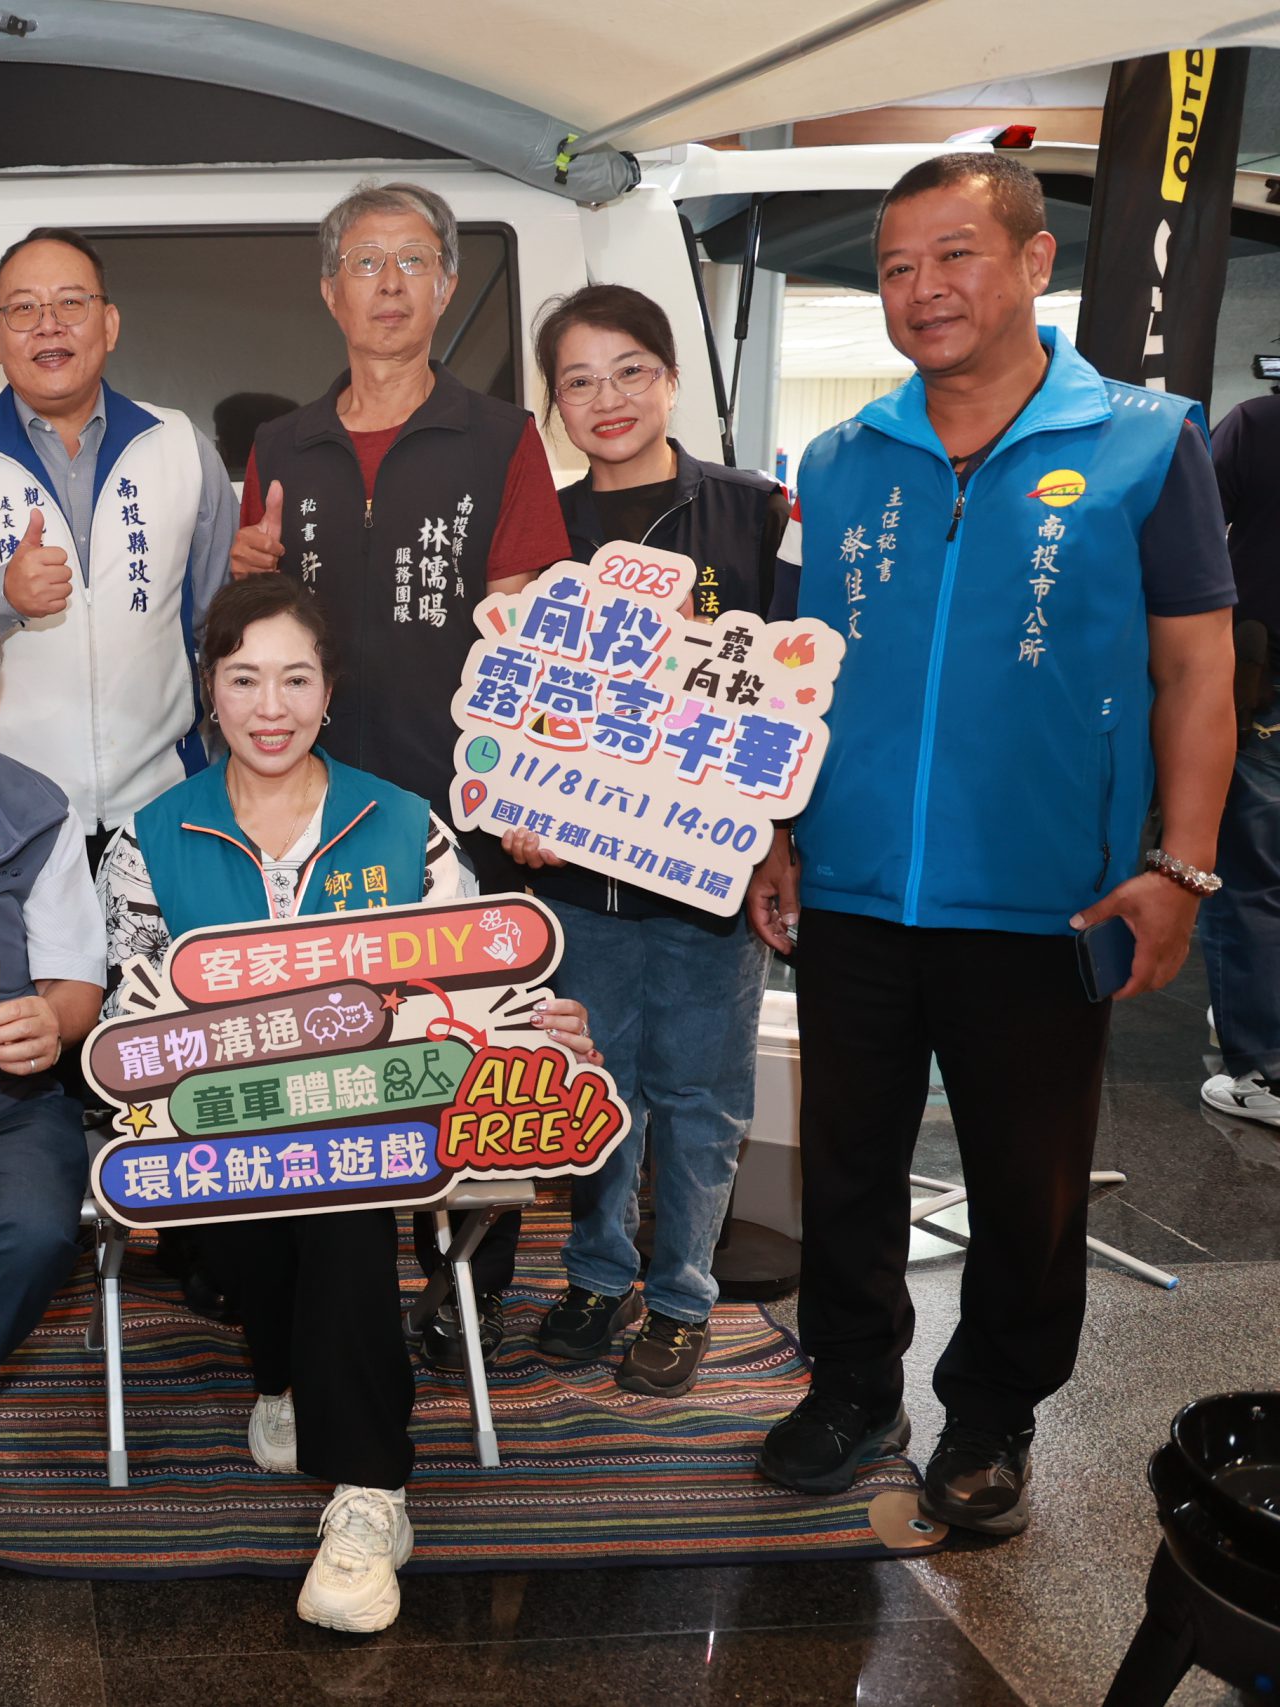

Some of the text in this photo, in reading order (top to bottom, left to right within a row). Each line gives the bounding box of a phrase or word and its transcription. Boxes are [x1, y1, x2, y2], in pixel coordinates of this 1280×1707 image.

[0, 496, 15, 529] 處長
[116, 477, 151, 613] 南投縣政府
[875, 486, 903, 582] 主任秘書
[393, 547, 414, 623] 服務團隊
[418, 517, 451, 628] 林儒暘
[599, 555, 680, 598] 2025
[698, 566, 720, 625] 立法
[839, 525, 872, 640] 蔡佳文
[1018, 514, 1066, 667] 南投市公所
[519, 576, 668, 676] 南投
[683, 626, 753, 664] 一露
[682, 658, 765, 707] 向投
[464, 645, 808, 797] 露營嘉年華
[508, 752, 758, 854] 11/8(六) 14:00
[490, 797, 734, 900] 國姓鄉成功廣場
[199, 922, 474, 992] 客家手作DIY
[118, 1007, 304, 1081] 寵物溝通
[191, 1062, 381, 1130] 童軍體驗
[466, 1058, 563, 1107] ALL
[122, 1130, 430, 1203] 環保魷魚遊戲
